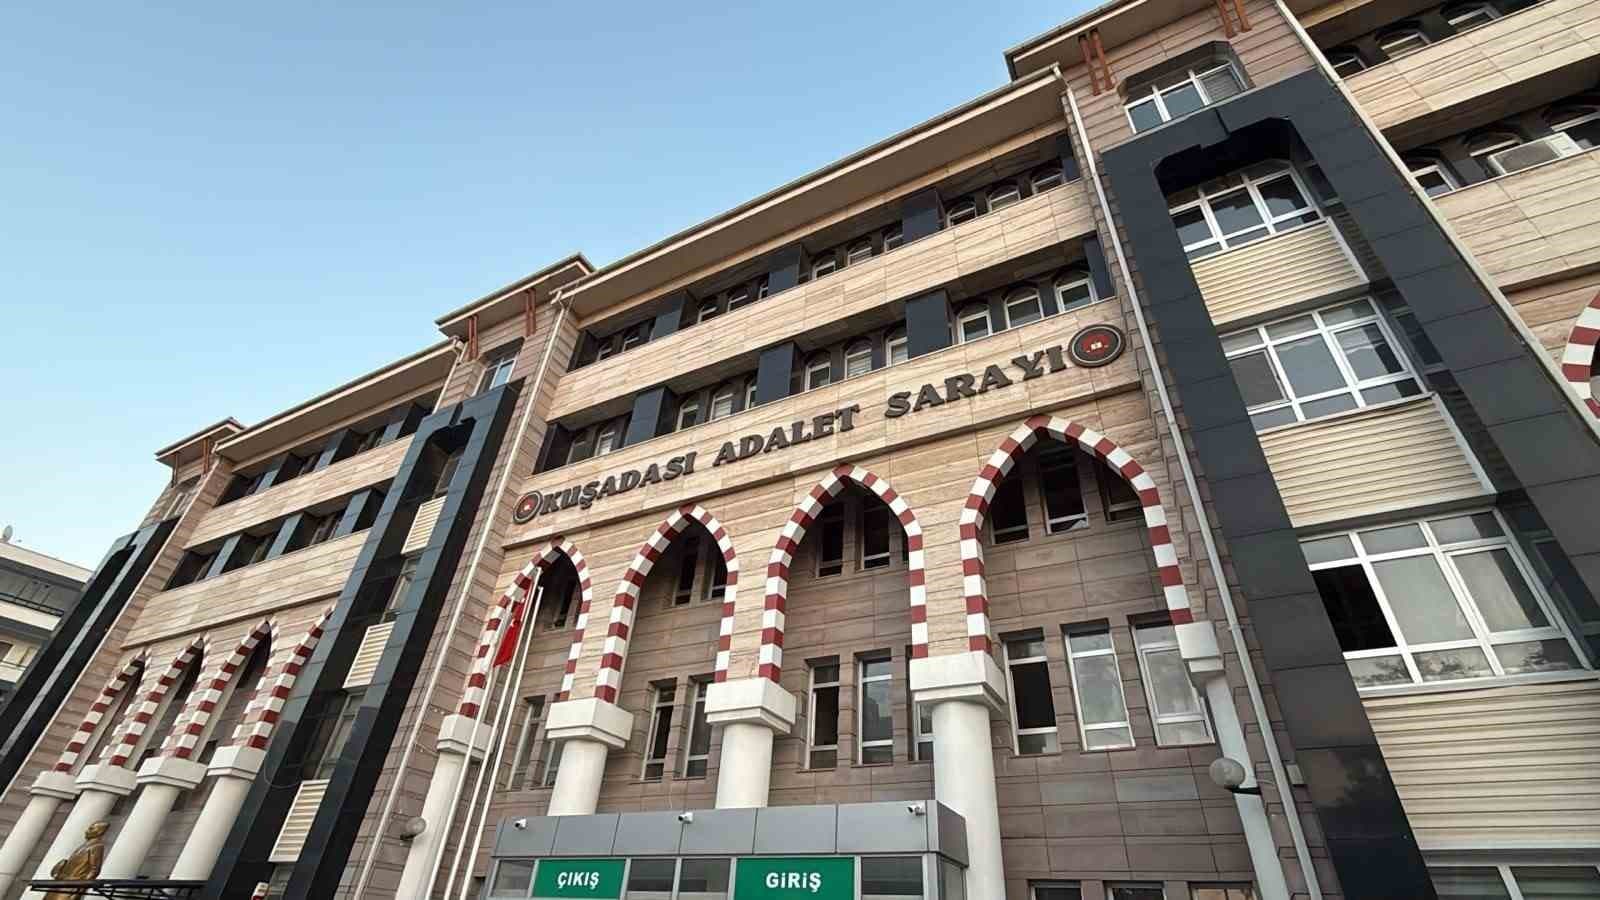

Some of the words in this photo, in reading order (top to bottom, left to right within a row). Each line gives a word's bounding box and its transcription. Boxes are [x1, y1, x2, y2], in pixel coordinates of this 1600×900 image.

[540, 451, 697, 515] KUŞADASI
[712, 404, 860, 467] ADALET
[885, 345, 1066, 418] SARAYI
[557, 871, 600, 890] ÇIKIŞ
